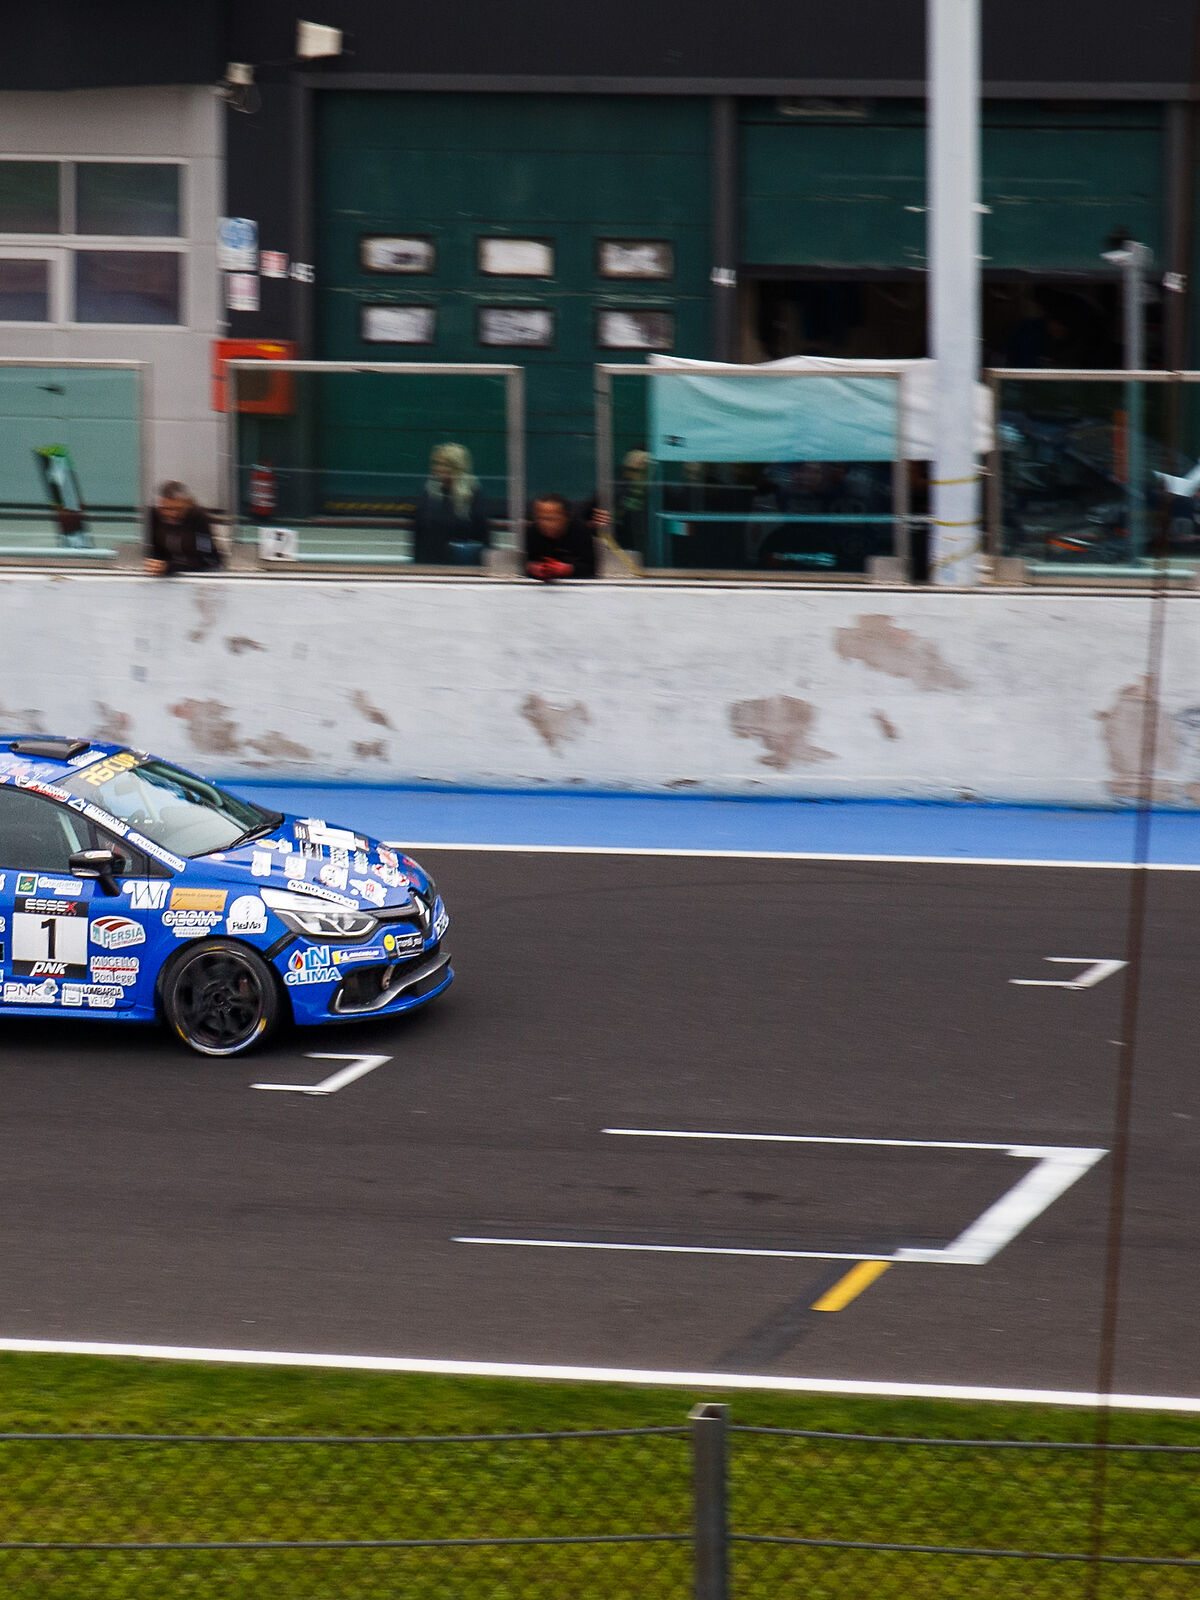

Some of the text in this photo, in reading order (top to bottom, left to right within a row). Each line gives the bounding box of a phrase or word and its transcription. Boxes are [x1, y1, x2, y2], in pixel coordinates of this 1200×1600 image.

[25, 899, 77, 912] ESSEX
[41, 918, 56, 960] 1
[103, 927, 143, 945] PERSIA
[30, 961, 69, 976] PNK
[285, 967, 342, 985] CLIMA
[5, 985, 42, 996] PNK
[82, 985, 123, 997] LOMBARDA
[89, 996, 115, 1006] VETRO
